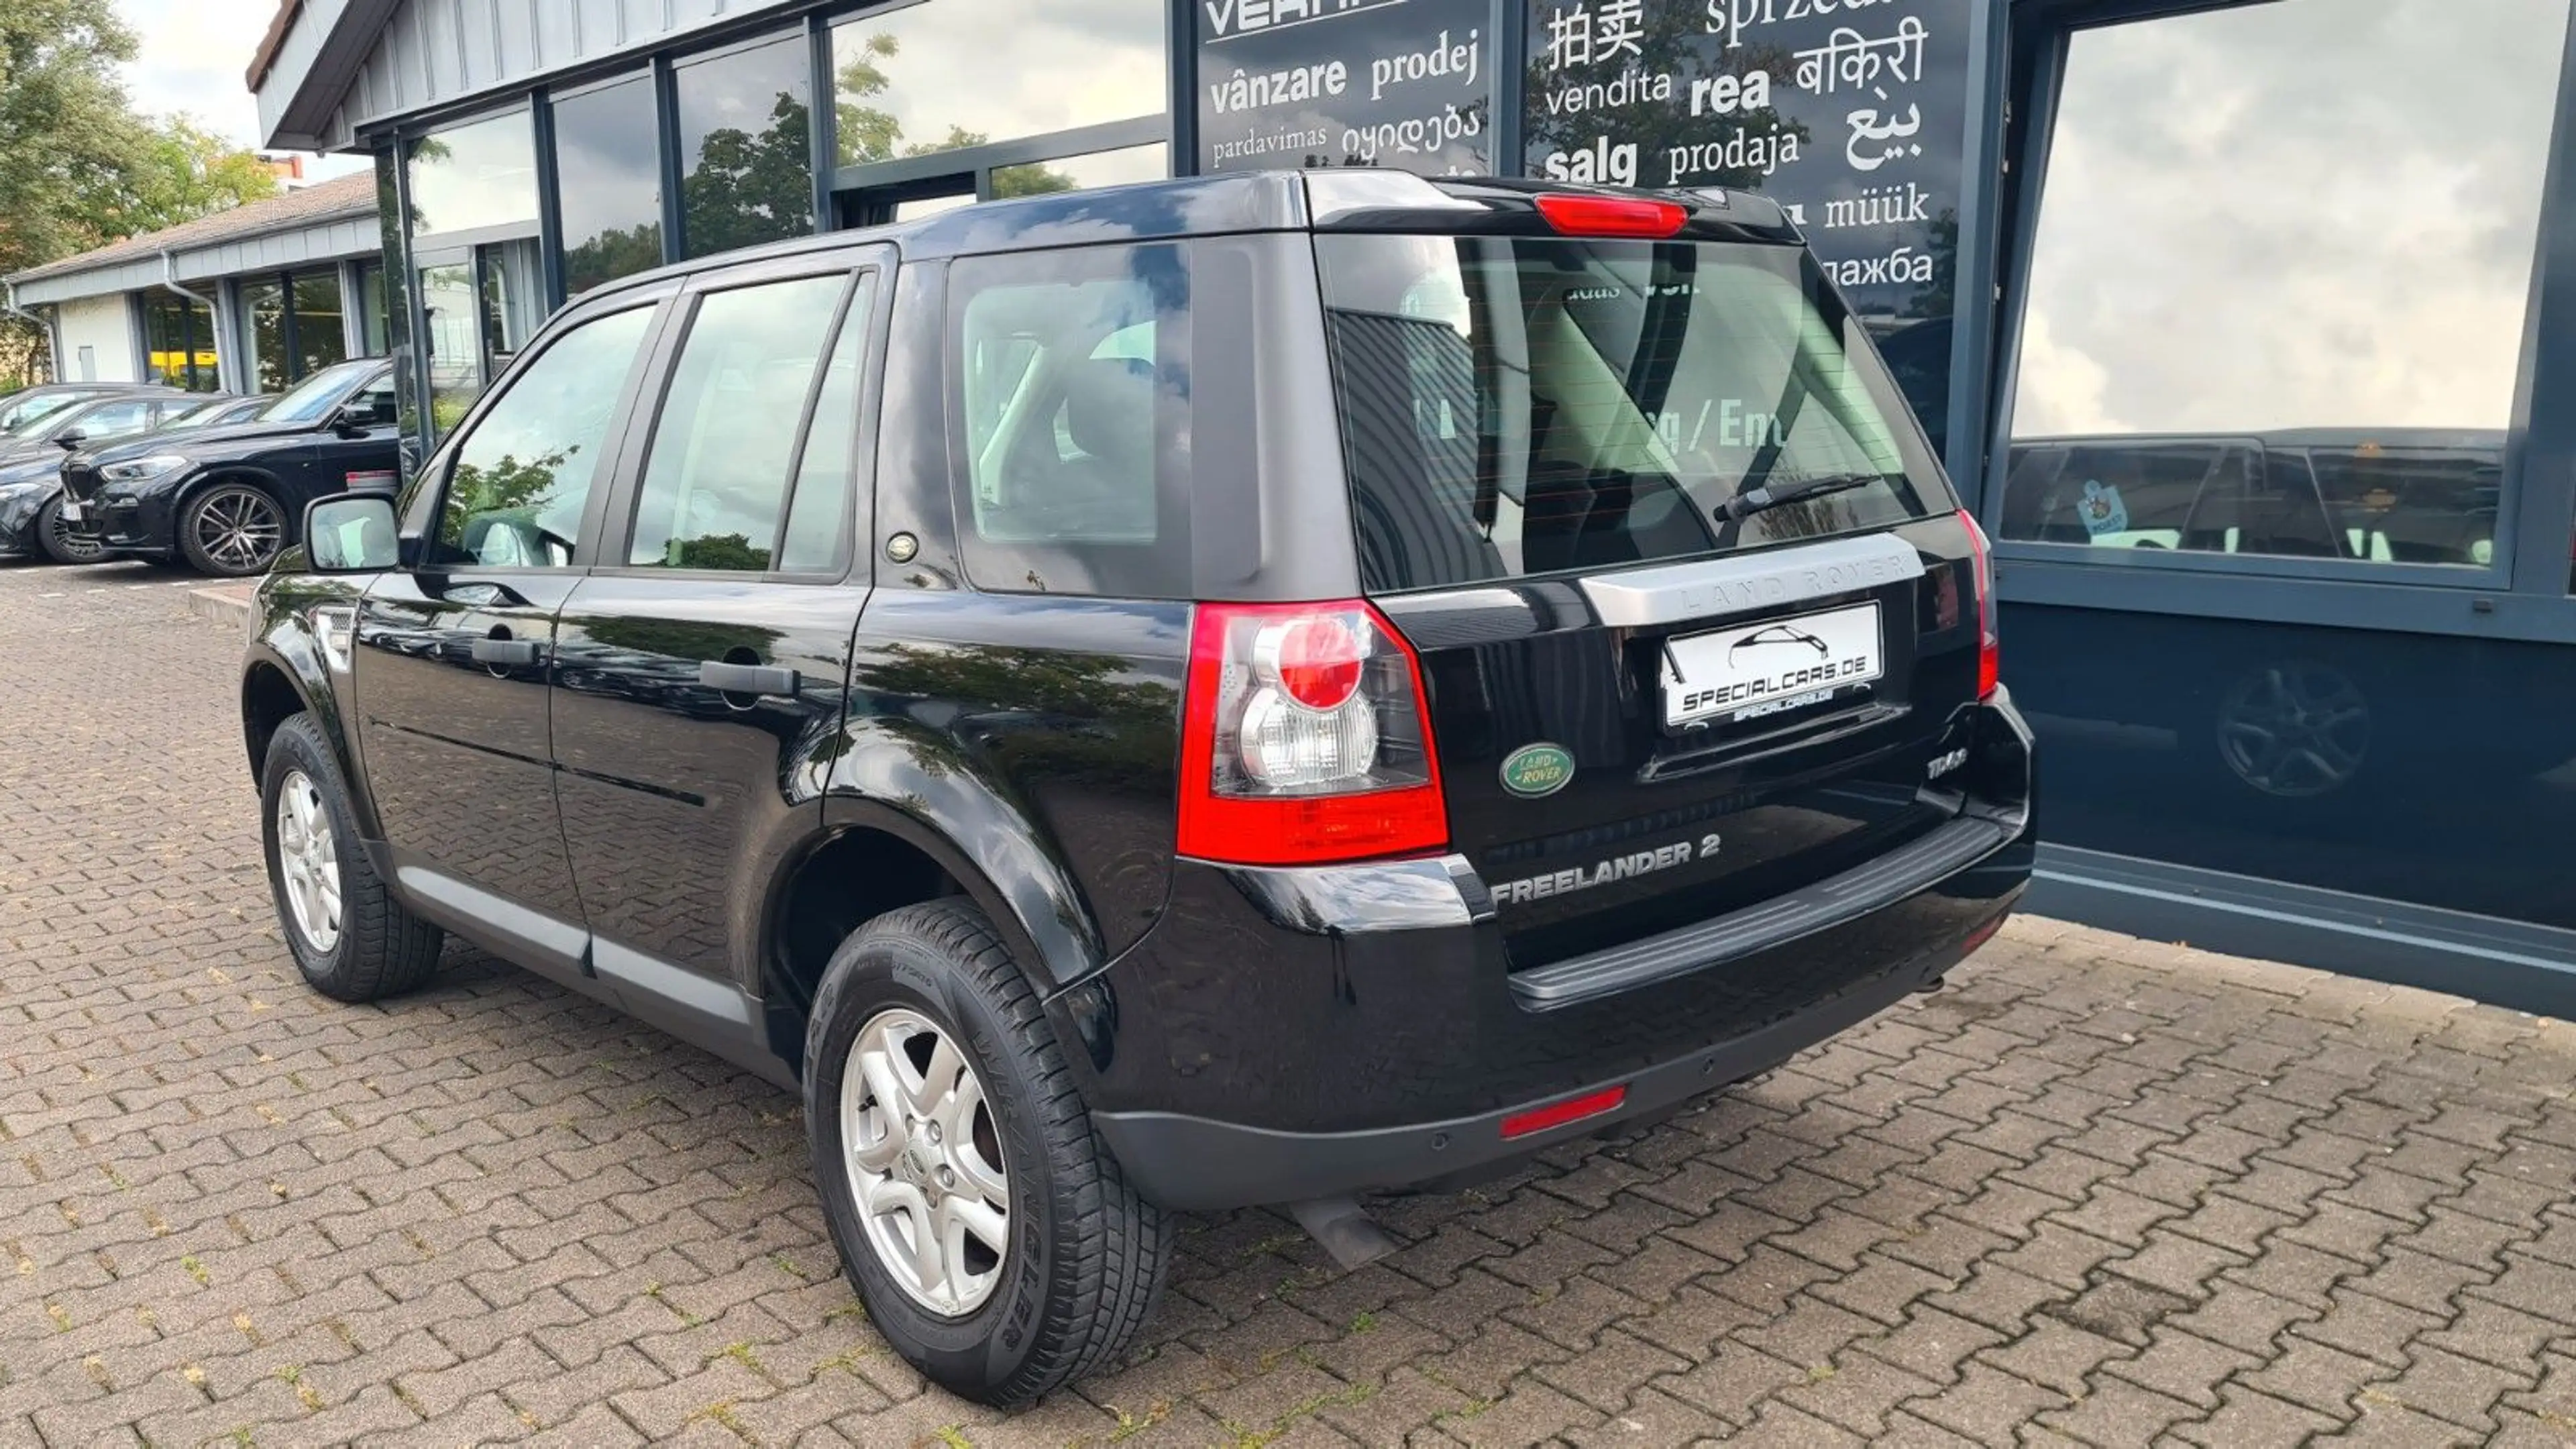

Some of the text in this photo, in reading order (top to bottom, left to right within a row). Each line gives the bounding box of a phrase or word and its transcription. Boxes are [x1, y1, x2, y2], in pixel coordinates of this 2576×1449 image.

[1547, 0, 1644, 70] 拍卖
[1210, 60, 1347, 114] vânzare
[1371, 28, 1479, 101] prodej
[1546, 70, 1671, 115] vendita
[1690, 70, 1770, 117] rea
[1213, 124, 1327, 168] pardavimas
[1342, 103, 1480, 160] იყიდება
[1668, 123, 1800, 185] prodaja
[1545, 135, 1638, 188] salg
[1824, 182, 1930, 228] müük
[1679, 553, 1908, 610] LAND ROVER
[1682, 655, 1867, 711] SPECIALCARS.DE
[1519, 754, 1552, 771] LAND
[1523, 766, 1562, 784] ROVER
[1490, 833, 1721, 906] FREELANDER 2
